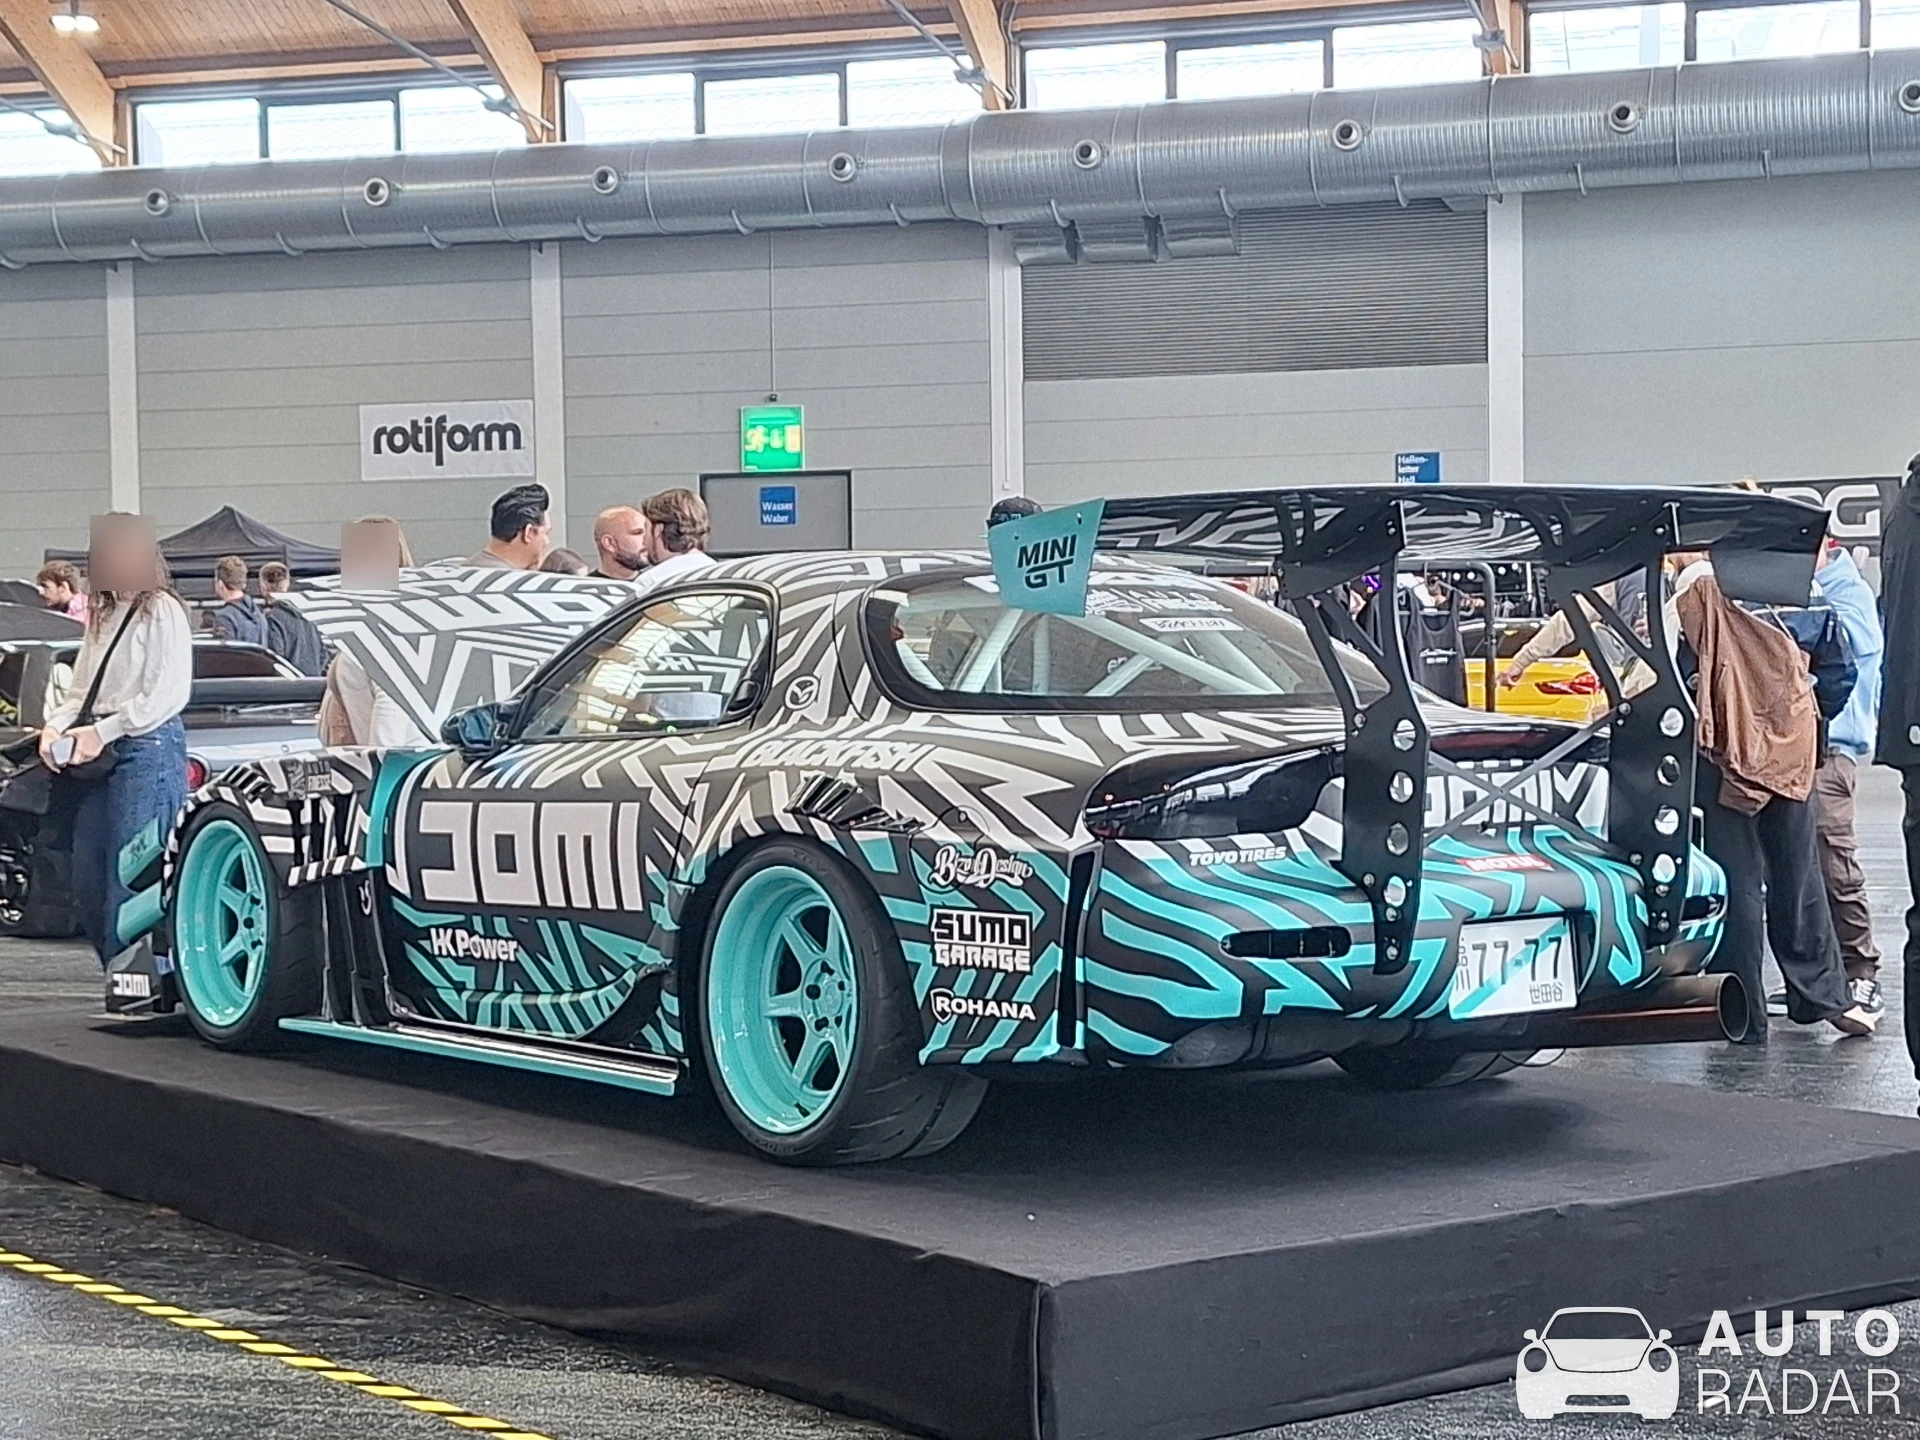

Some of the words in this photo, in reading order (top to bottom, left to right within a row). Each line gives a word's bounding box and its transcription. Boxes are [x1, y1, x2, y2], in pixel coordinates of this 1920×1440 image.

[373, 414, 522, 466] rotiform
[1017, 533, 1077, 568] MINI
[1025, 558, 1074, 589] GT
[740, 740, 936, 772] BLACKFISH
[1189, 851, 1238, 867] TOYO
[1239, 846, 1287, 863] TIRES
[1467, 855, 1544, 872] MOTUL
[934, 911, 1028, 947] SUMO
[934, 943, 1031, 973] GARAGE
[1529, 982, 1563, 1004] 世田谷
[936, 996, 1036, 1021] ROHANA
